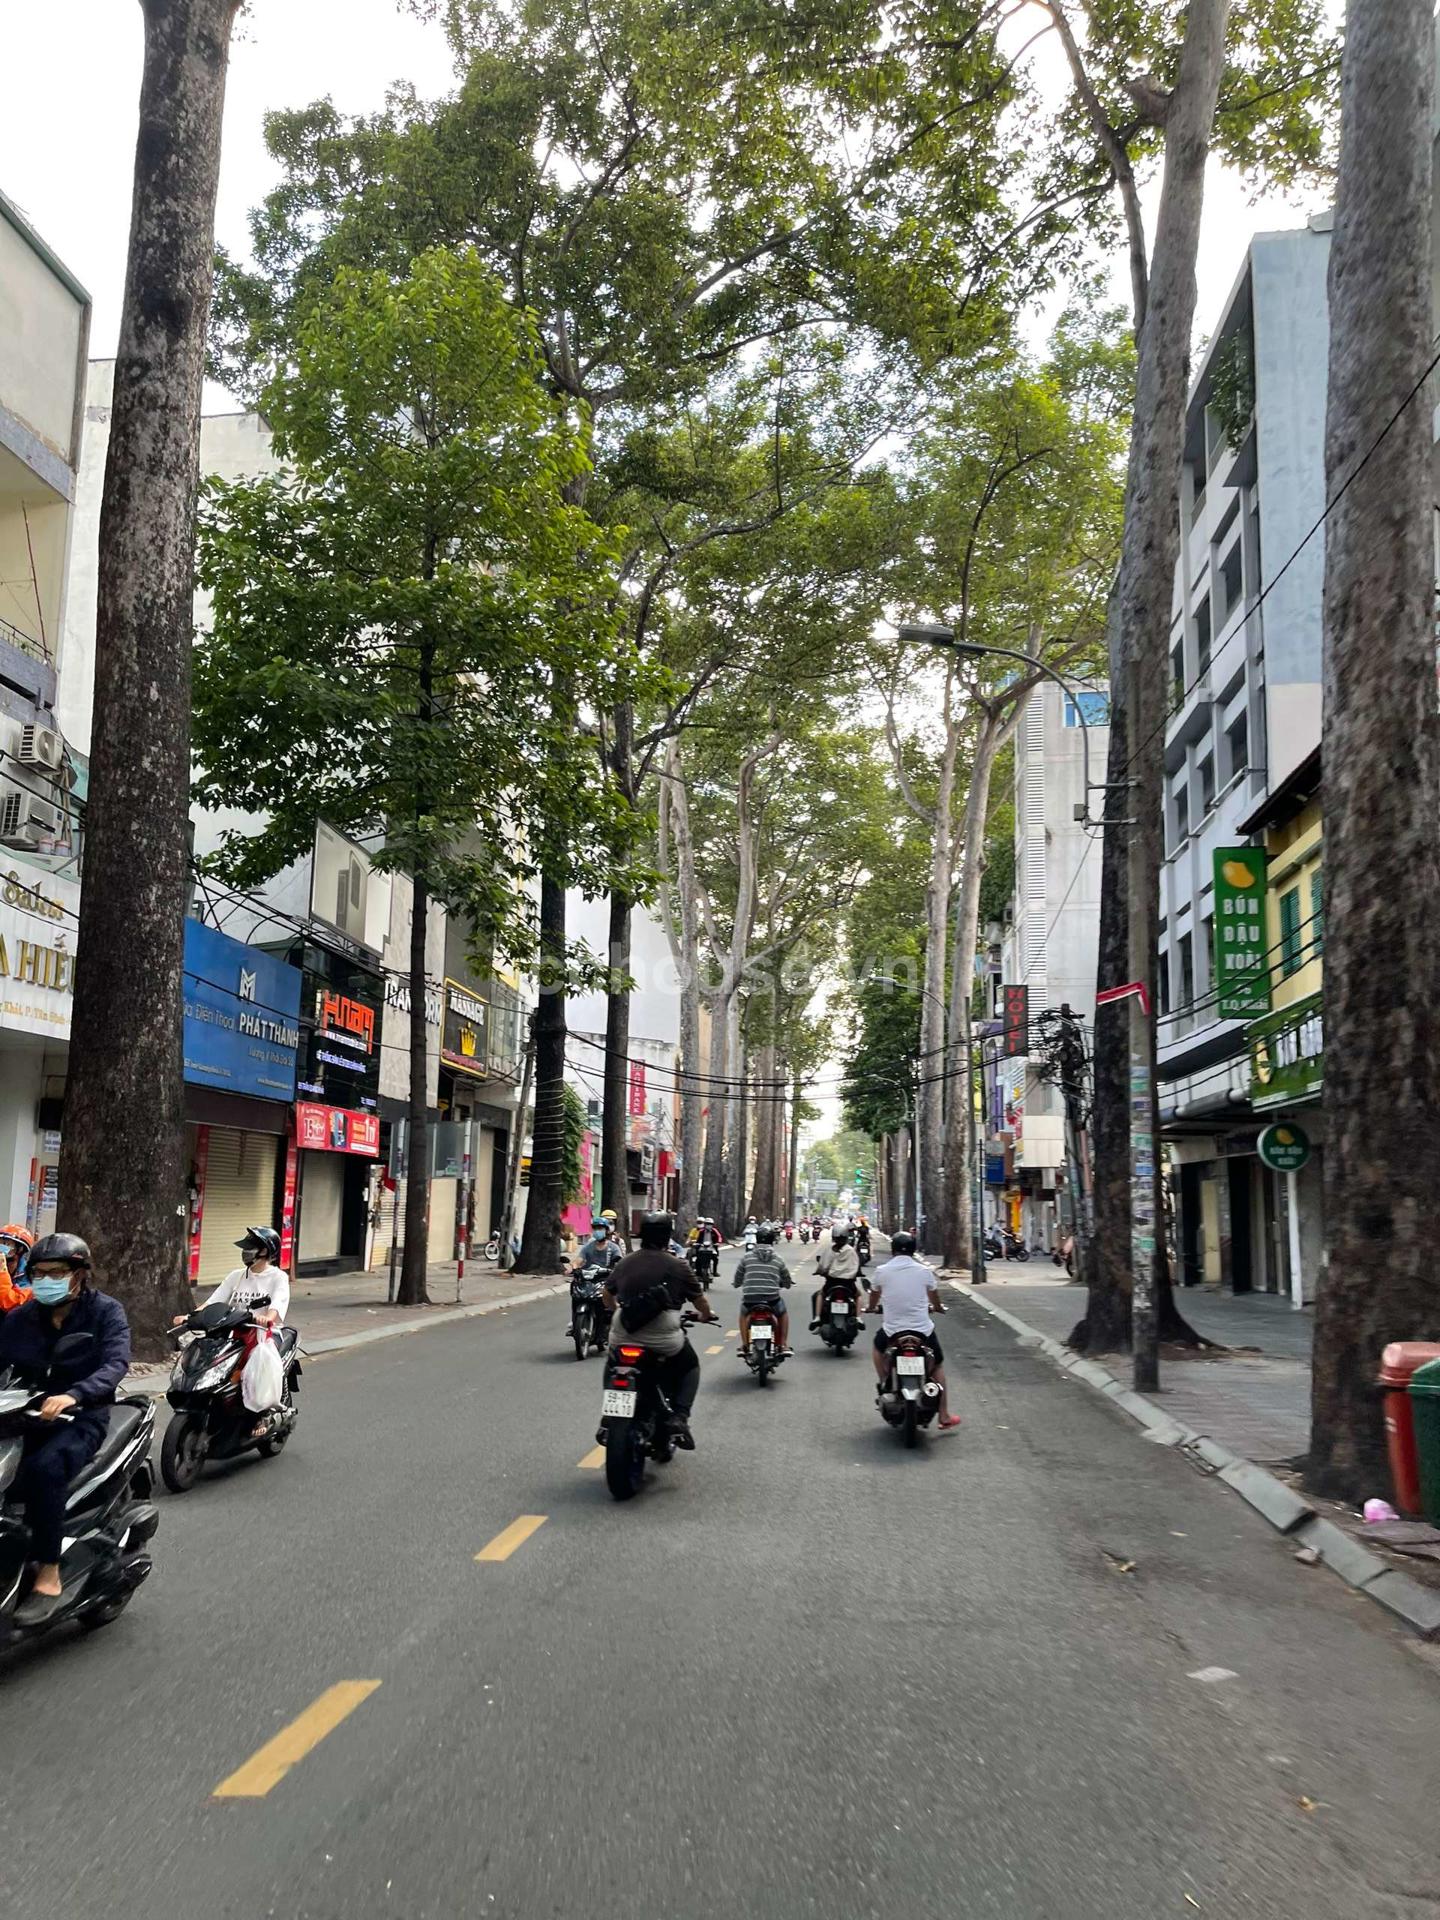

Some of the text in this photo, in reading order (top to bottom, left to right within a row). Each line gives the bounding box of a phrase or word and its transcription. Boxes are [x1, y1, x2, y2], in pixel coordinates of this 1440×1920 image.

[1223, 895, 1259, 915] BÚN
[1223, 922, 1260, 945] ĐẬU
[240, 1010, 268, 1039] PHÁT
